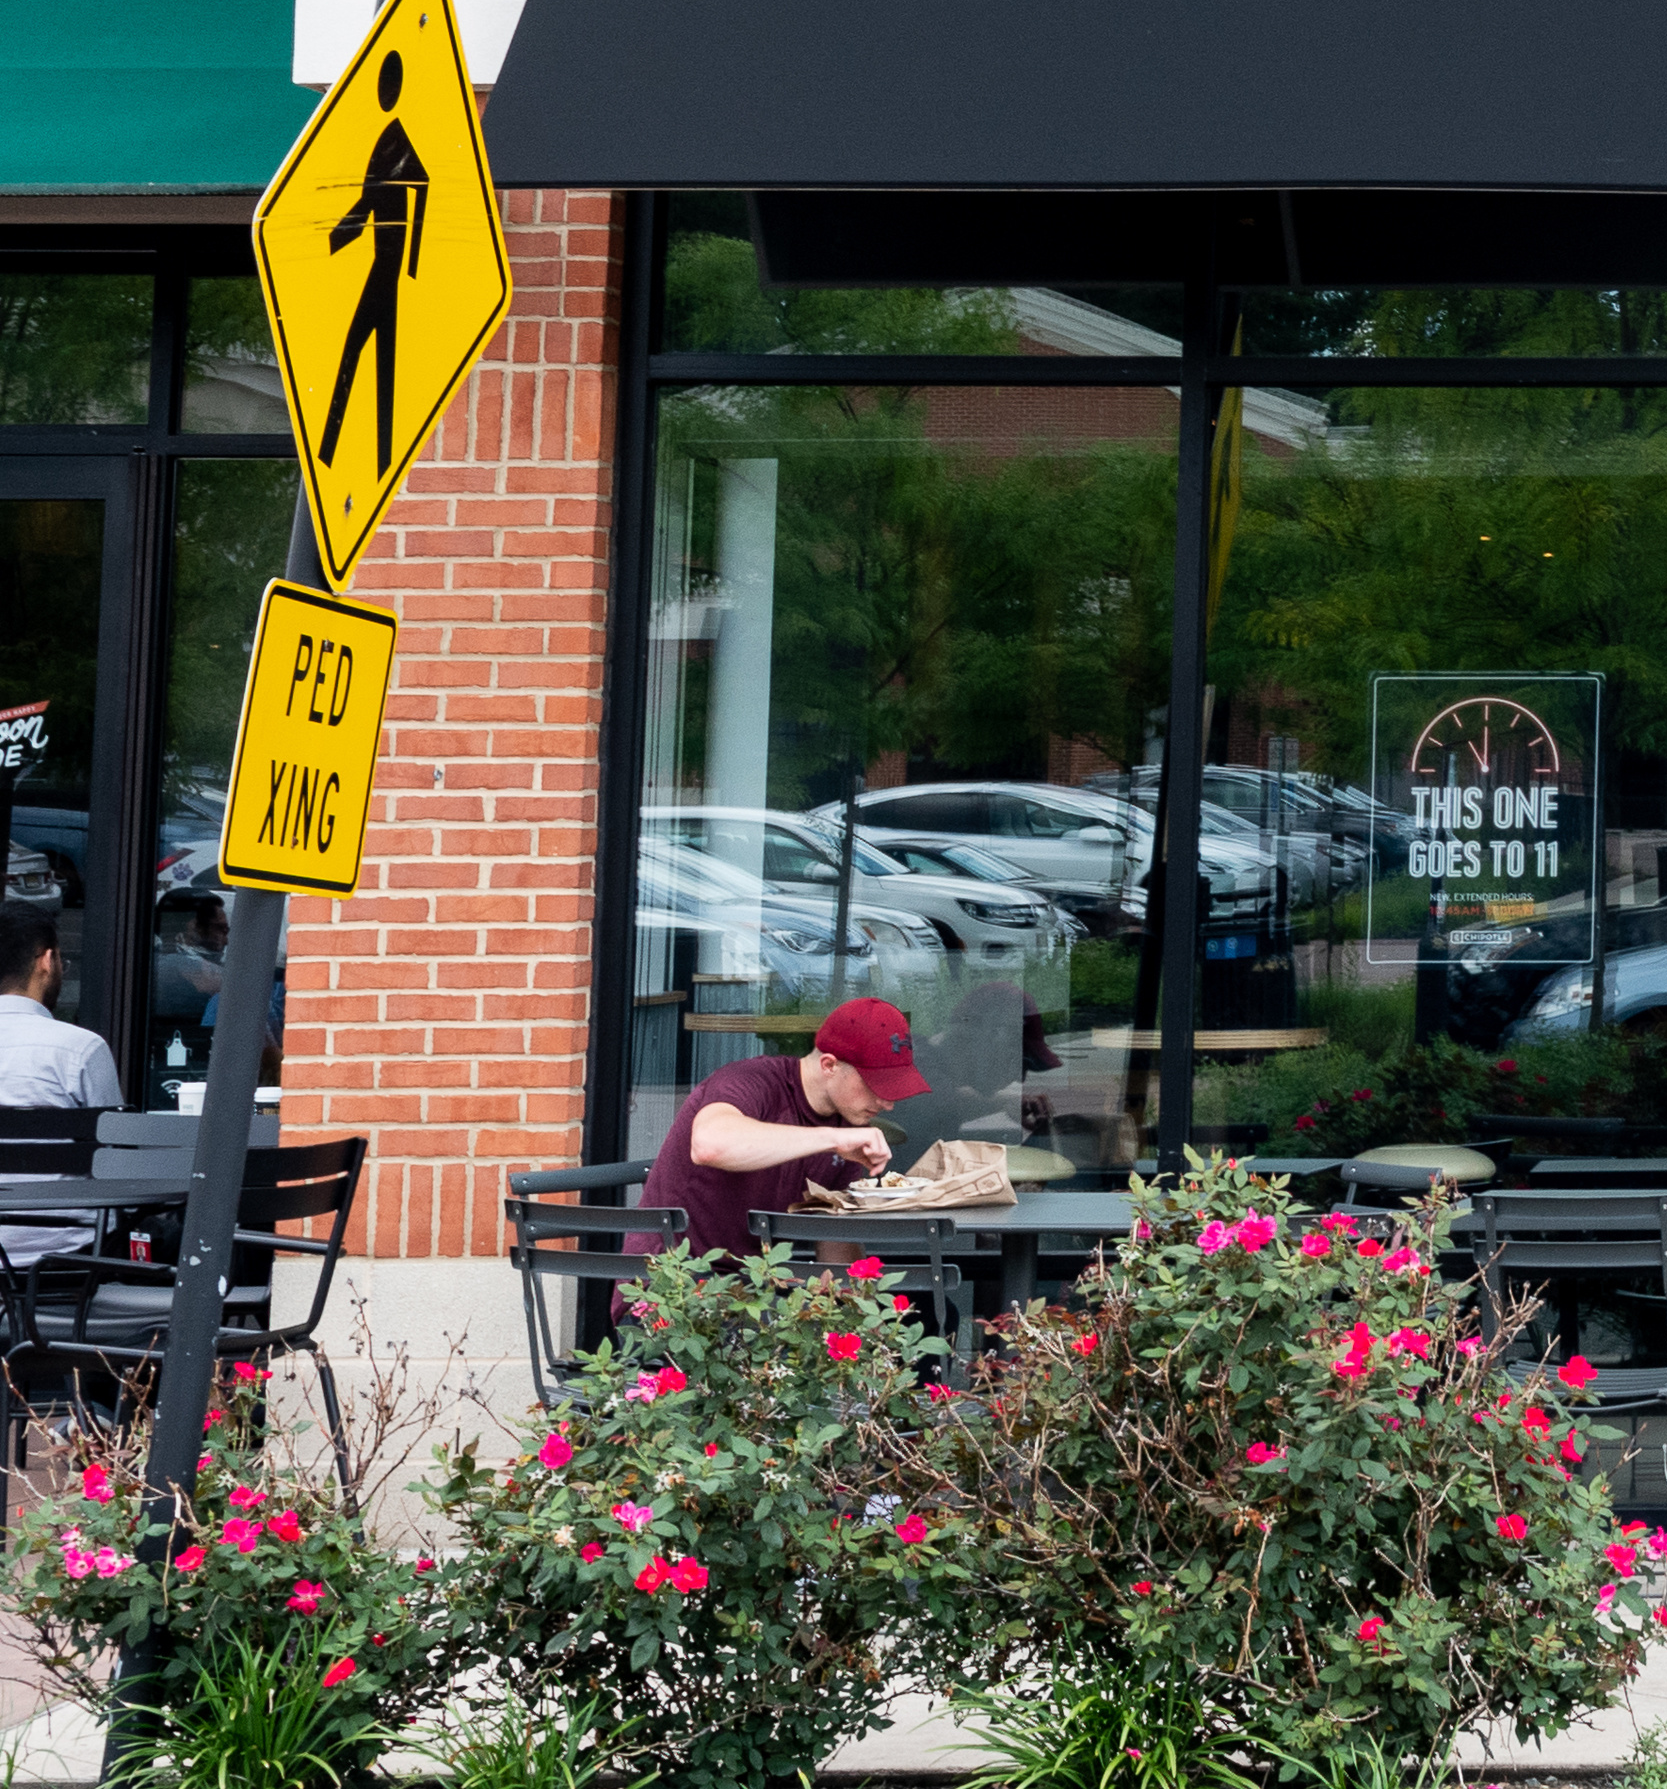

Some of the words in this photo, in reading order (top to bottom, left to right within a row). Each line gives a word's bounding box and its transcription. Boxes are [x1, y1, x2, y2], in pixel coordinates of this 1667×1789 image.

[285, 634, 354, 727] PED
[257, 759, 341, 854] XING
[1411, 787, 1483, 829] THIS
[1493, 787, 1558, 829] ONE
[1408, 840, 1481, 878] GOES
[1490, 840, 1524, 878] TO
[1534, 840, 1558, 878] 11
[1454, 892, 1500, 902] EXTENDED
[1464, 933, 1508, 941] CHIPOTLE
